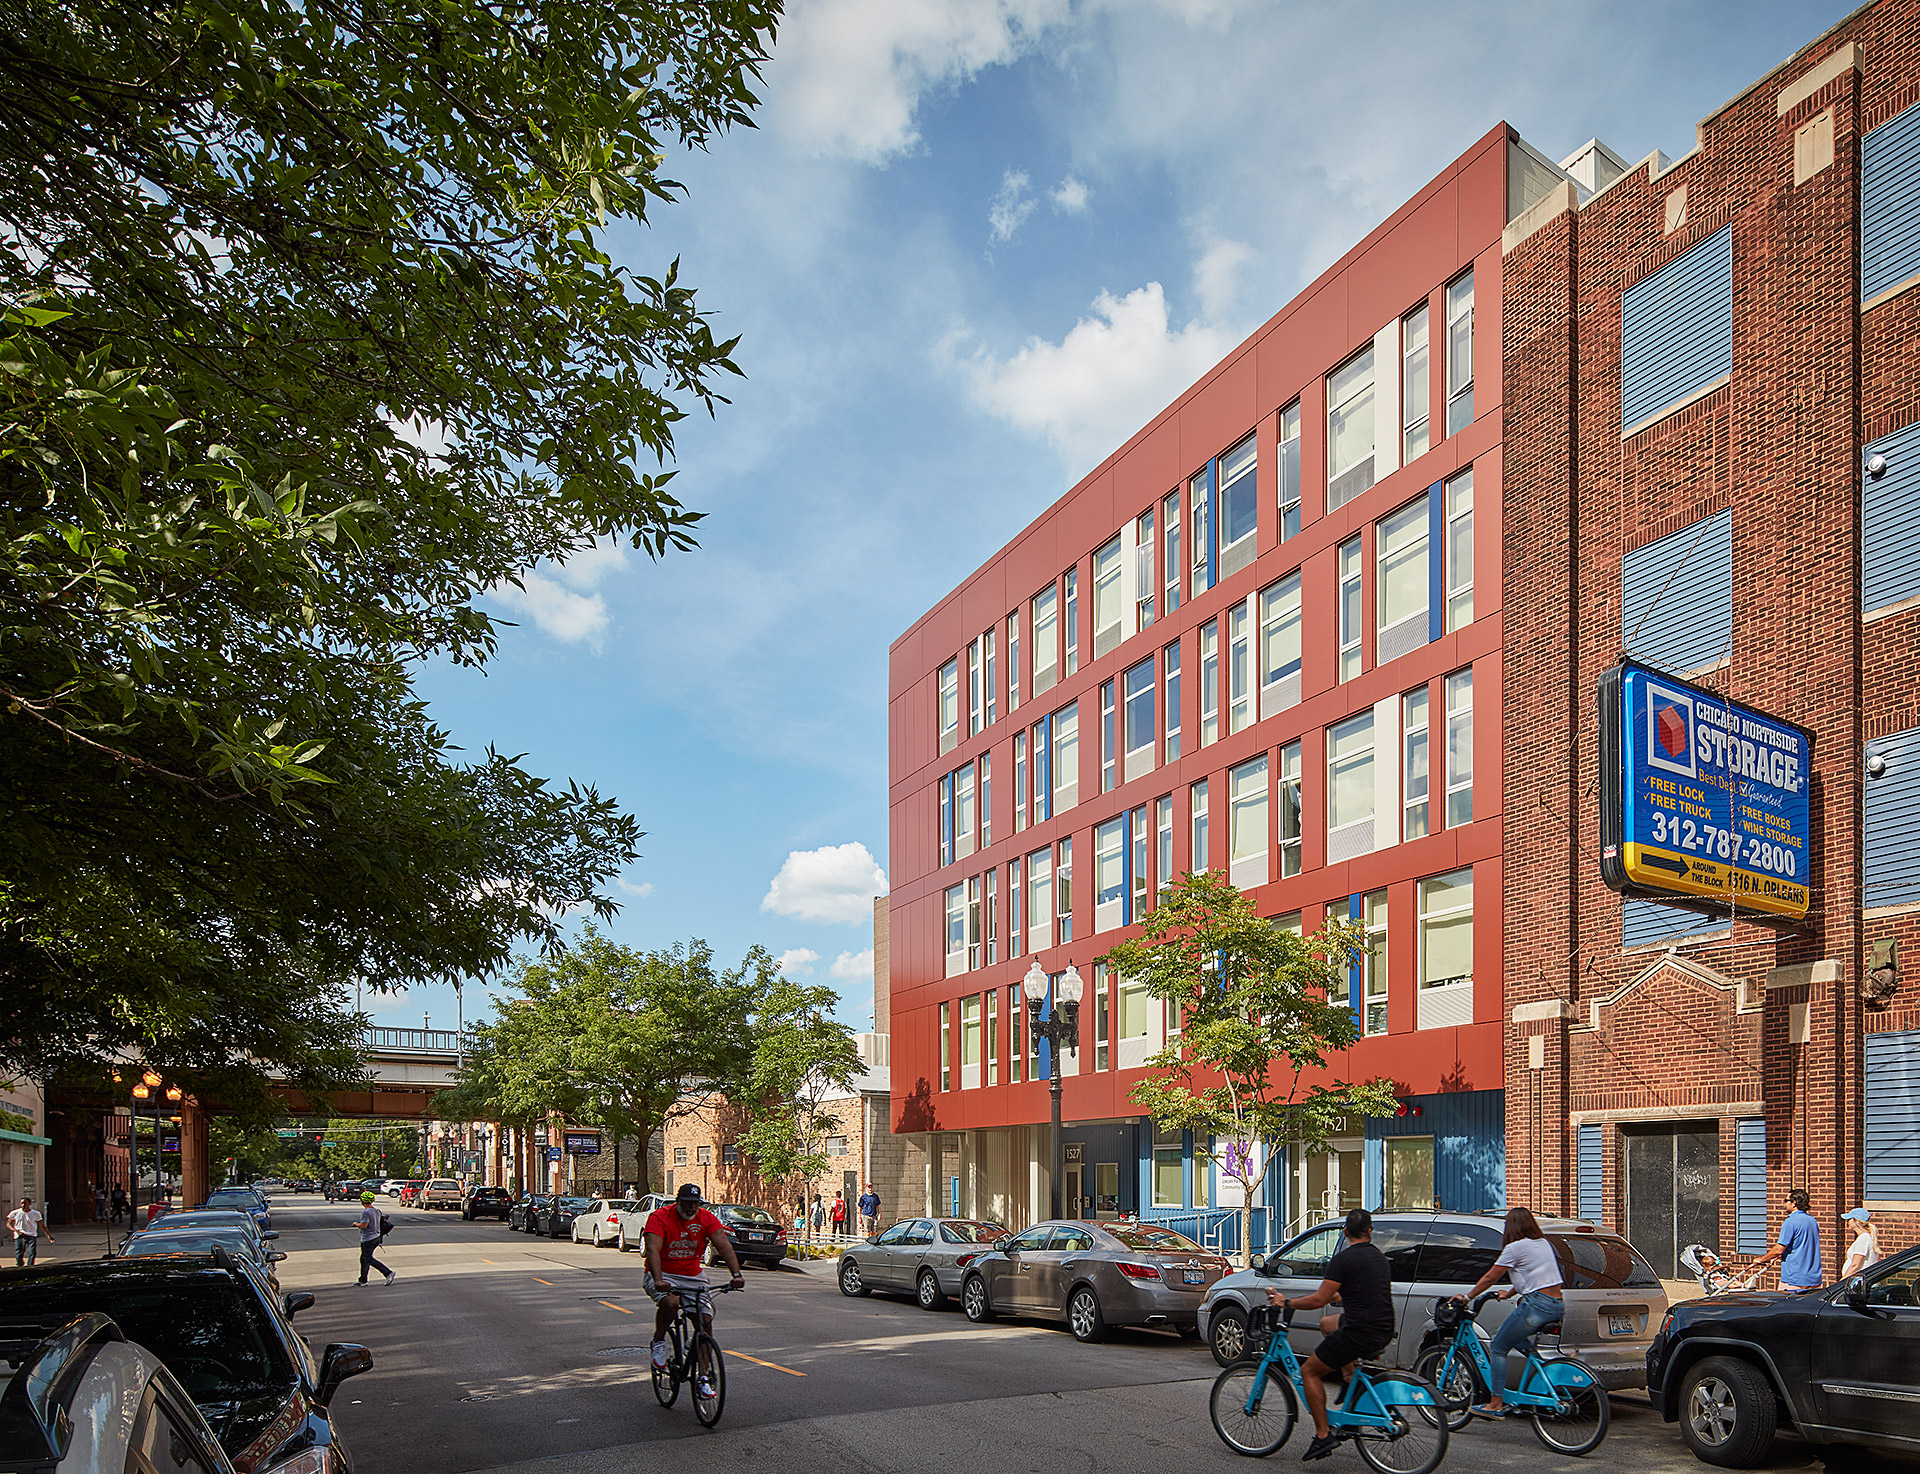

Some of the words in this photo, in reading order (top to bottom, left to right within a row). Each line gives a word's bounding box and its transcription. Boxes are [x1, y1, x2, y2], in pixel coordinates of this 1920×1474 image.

[1696, 701, 1740, 734] CHICAGO
[1741, 718, 1799, 755] NORTHSIDE
[1697, 724, 1799, 793] STORAGE
[1650, 776, 1676, 794] FREE
[1678, 784, 1705, 803] LOCK
[1698, 768, 1718, 787] Best
[1650, 793, 1677, 810] FREE
[1680, 801, 1712, 820] TRUCK
[1742, 805, 1763, 822] FREE
[1764, 812, 1791, 831] BOXES
[1651, 811, 1797, 878] 312-787-2800
[1742, 819, 1765, 838] WINE
[1765, 827, 1803, 849] STORAGE
[1691, 860, 1717, 875] AROUND
[1691, 872, 1704, 884] THE
[1703, 875, 1724, 889] BLOCK
[1751, 876, 1762, 894] N.
[1763, 880, 1805, 905] ORLEANS
[1066, 1148, 1080, 1159] 1527
